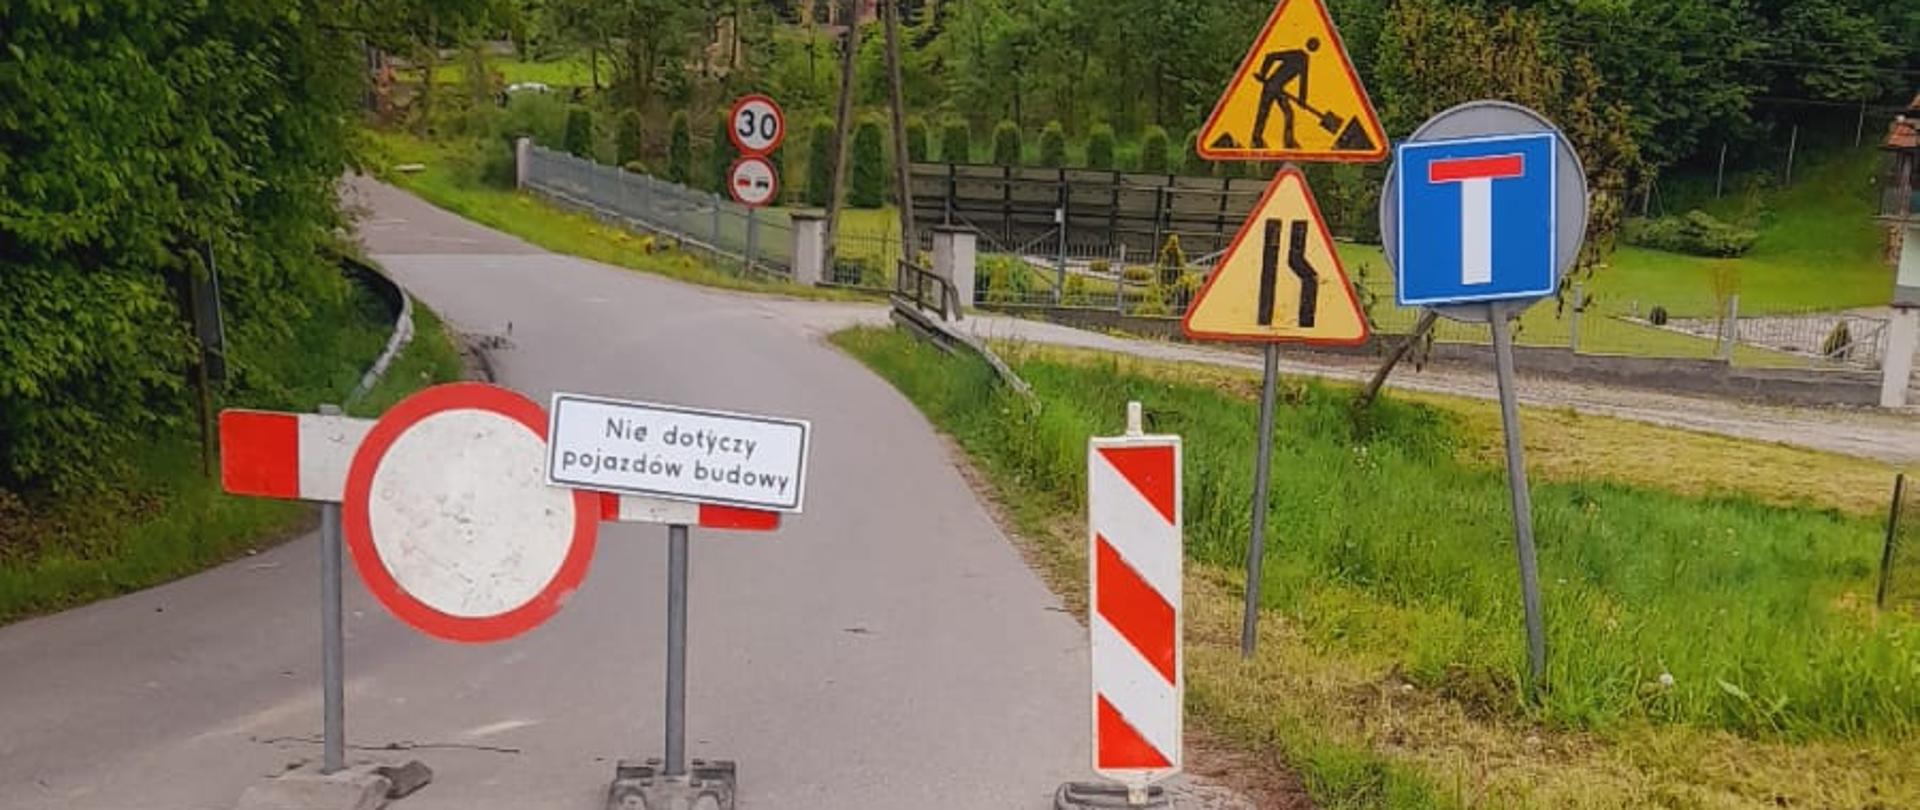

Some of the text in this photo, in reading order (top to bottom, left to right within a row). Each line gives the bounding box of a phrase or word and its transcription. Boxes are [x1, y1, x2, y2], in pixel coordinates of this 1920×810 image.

[739, 109, 777, 140] 30
[605, 417, 648, 442] Nie
[562, 448, 789, 495] pojazdów budowy
